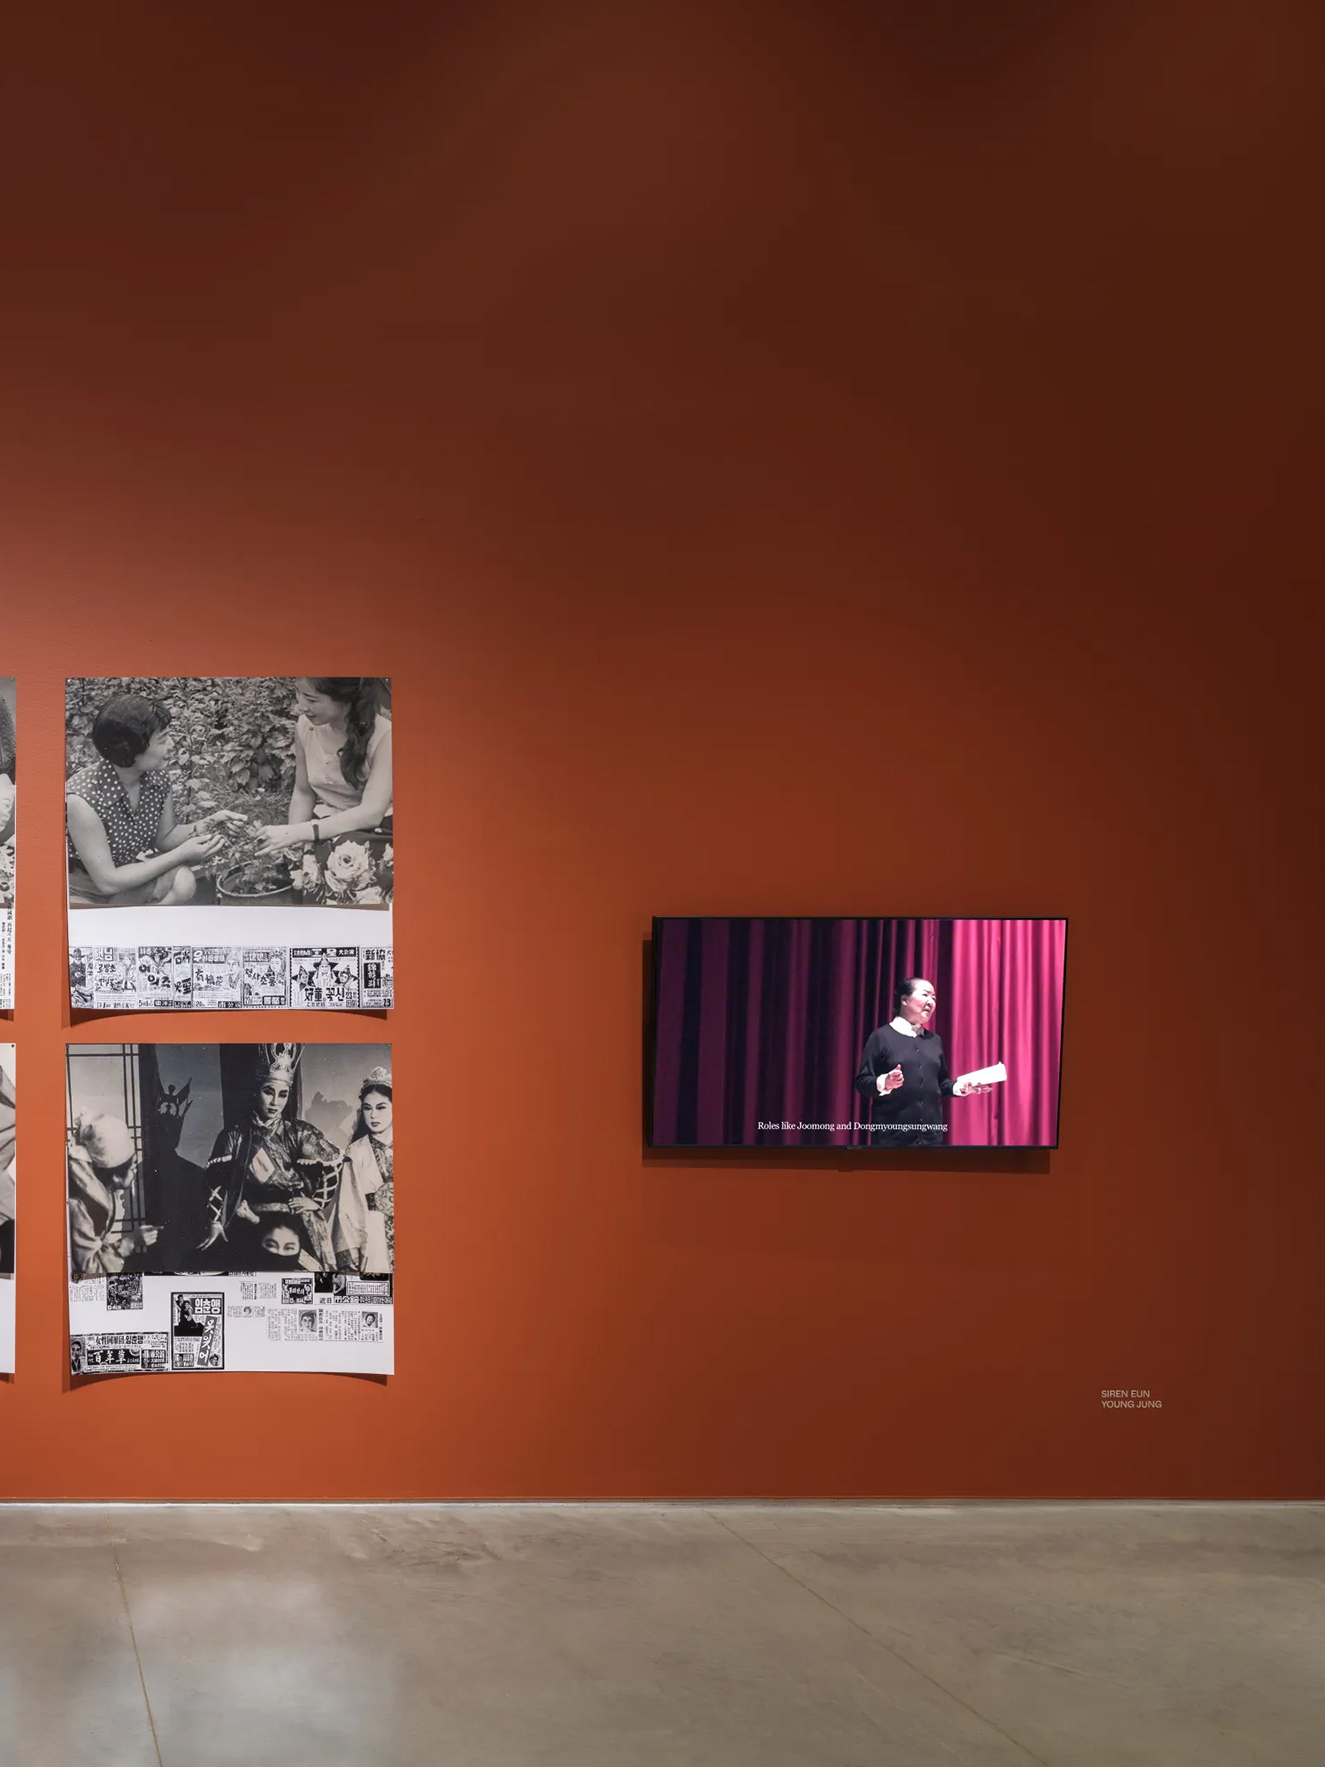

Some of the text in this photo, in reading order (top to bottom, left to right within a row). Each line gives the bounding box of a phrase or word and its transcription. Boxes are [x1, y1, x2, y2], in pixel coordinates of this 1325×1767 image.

[757, 1121, 949, 1132] Roles like Joomong and Dongmyoungsungwang
[1101, 1389, 1151, 1398] SIREN EUN
[1101, 1400, 1163, 1409] YOUNG JUNG
